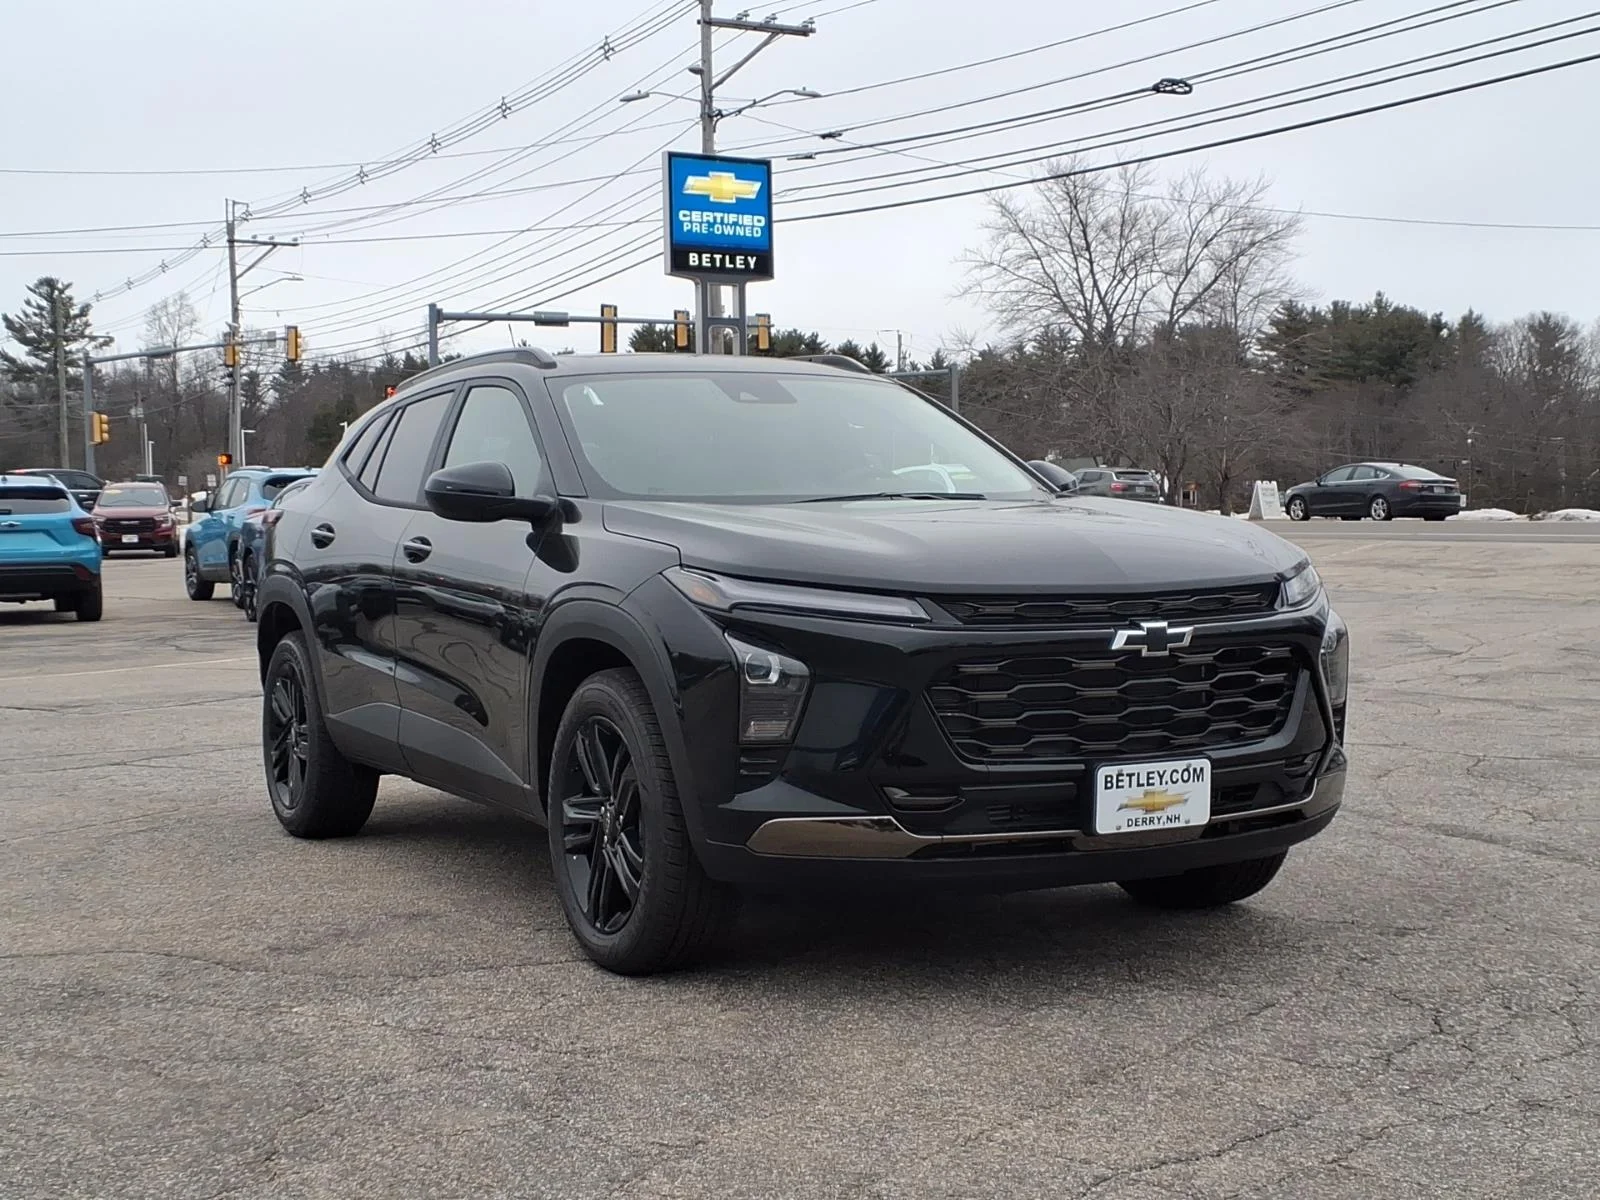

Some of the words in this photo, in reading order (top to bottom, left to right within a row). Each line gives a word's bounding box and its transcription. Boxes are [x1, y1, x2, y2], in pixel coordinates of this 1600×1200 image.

[679, 210, 765, 226] CERTIFIED
[683, 222, 761, 237] PRE-OWNED
[689, 252, 756, 269] BETLEY
[1104, 767, 1204, 790] BETLEY.COM
